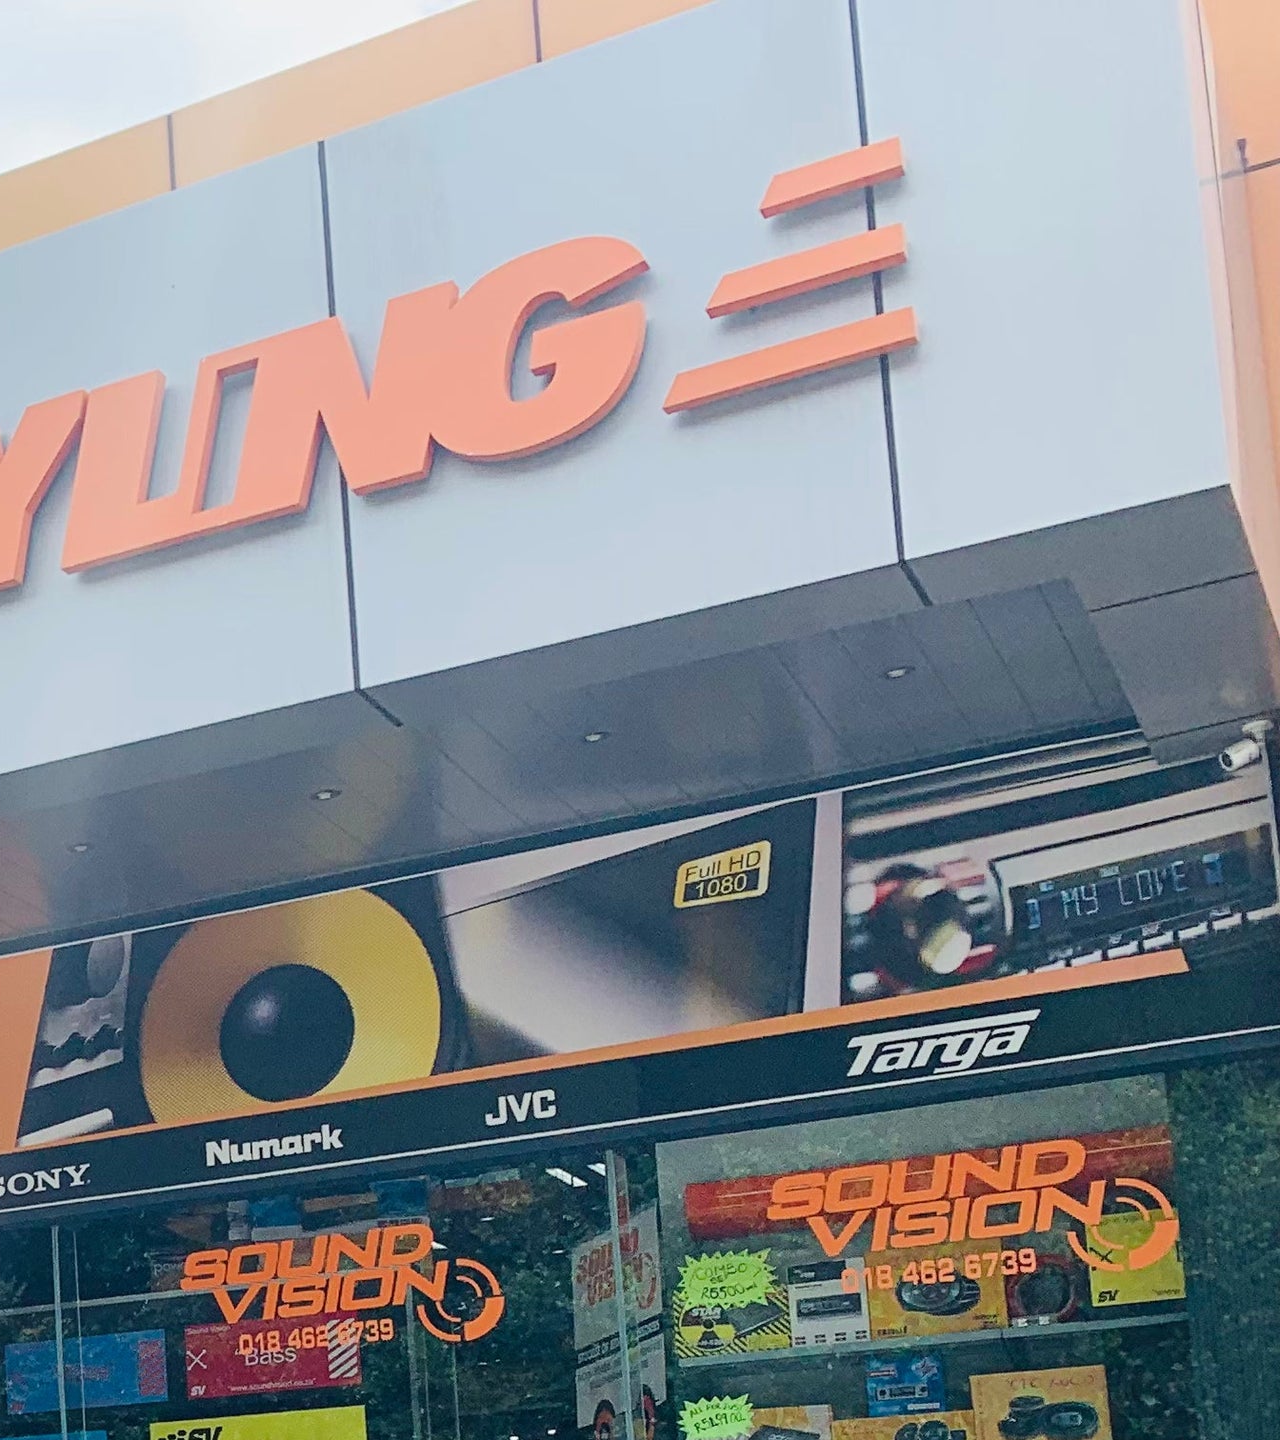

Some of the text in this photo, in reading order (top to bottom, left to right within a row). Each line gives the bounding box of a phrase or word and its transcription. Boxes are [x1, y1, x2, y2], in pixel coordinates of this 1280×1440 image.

[685, 850, 761, 882] Full HD
[695, 873, 748, 898] 1080
[846, 1008, 1041, 1079] Targa
[485, 1089, 557, 1126] JVC
[205, 1124, 344, 1167] Numark
[767, 1139, 1086, 1220] SOUND
[807, 1180, 1106, 1257] VISION
[180, 1224, 434, 1290] SOUND
[841, 1264, 893, 1292] 018
[902, 1257, 956, 1285] 462
[963, 1248, 1037, 1280] 6739
[213, 1260, 448, 1324] VISION
[239, 1318, 394, 1356] 018 462 6739
